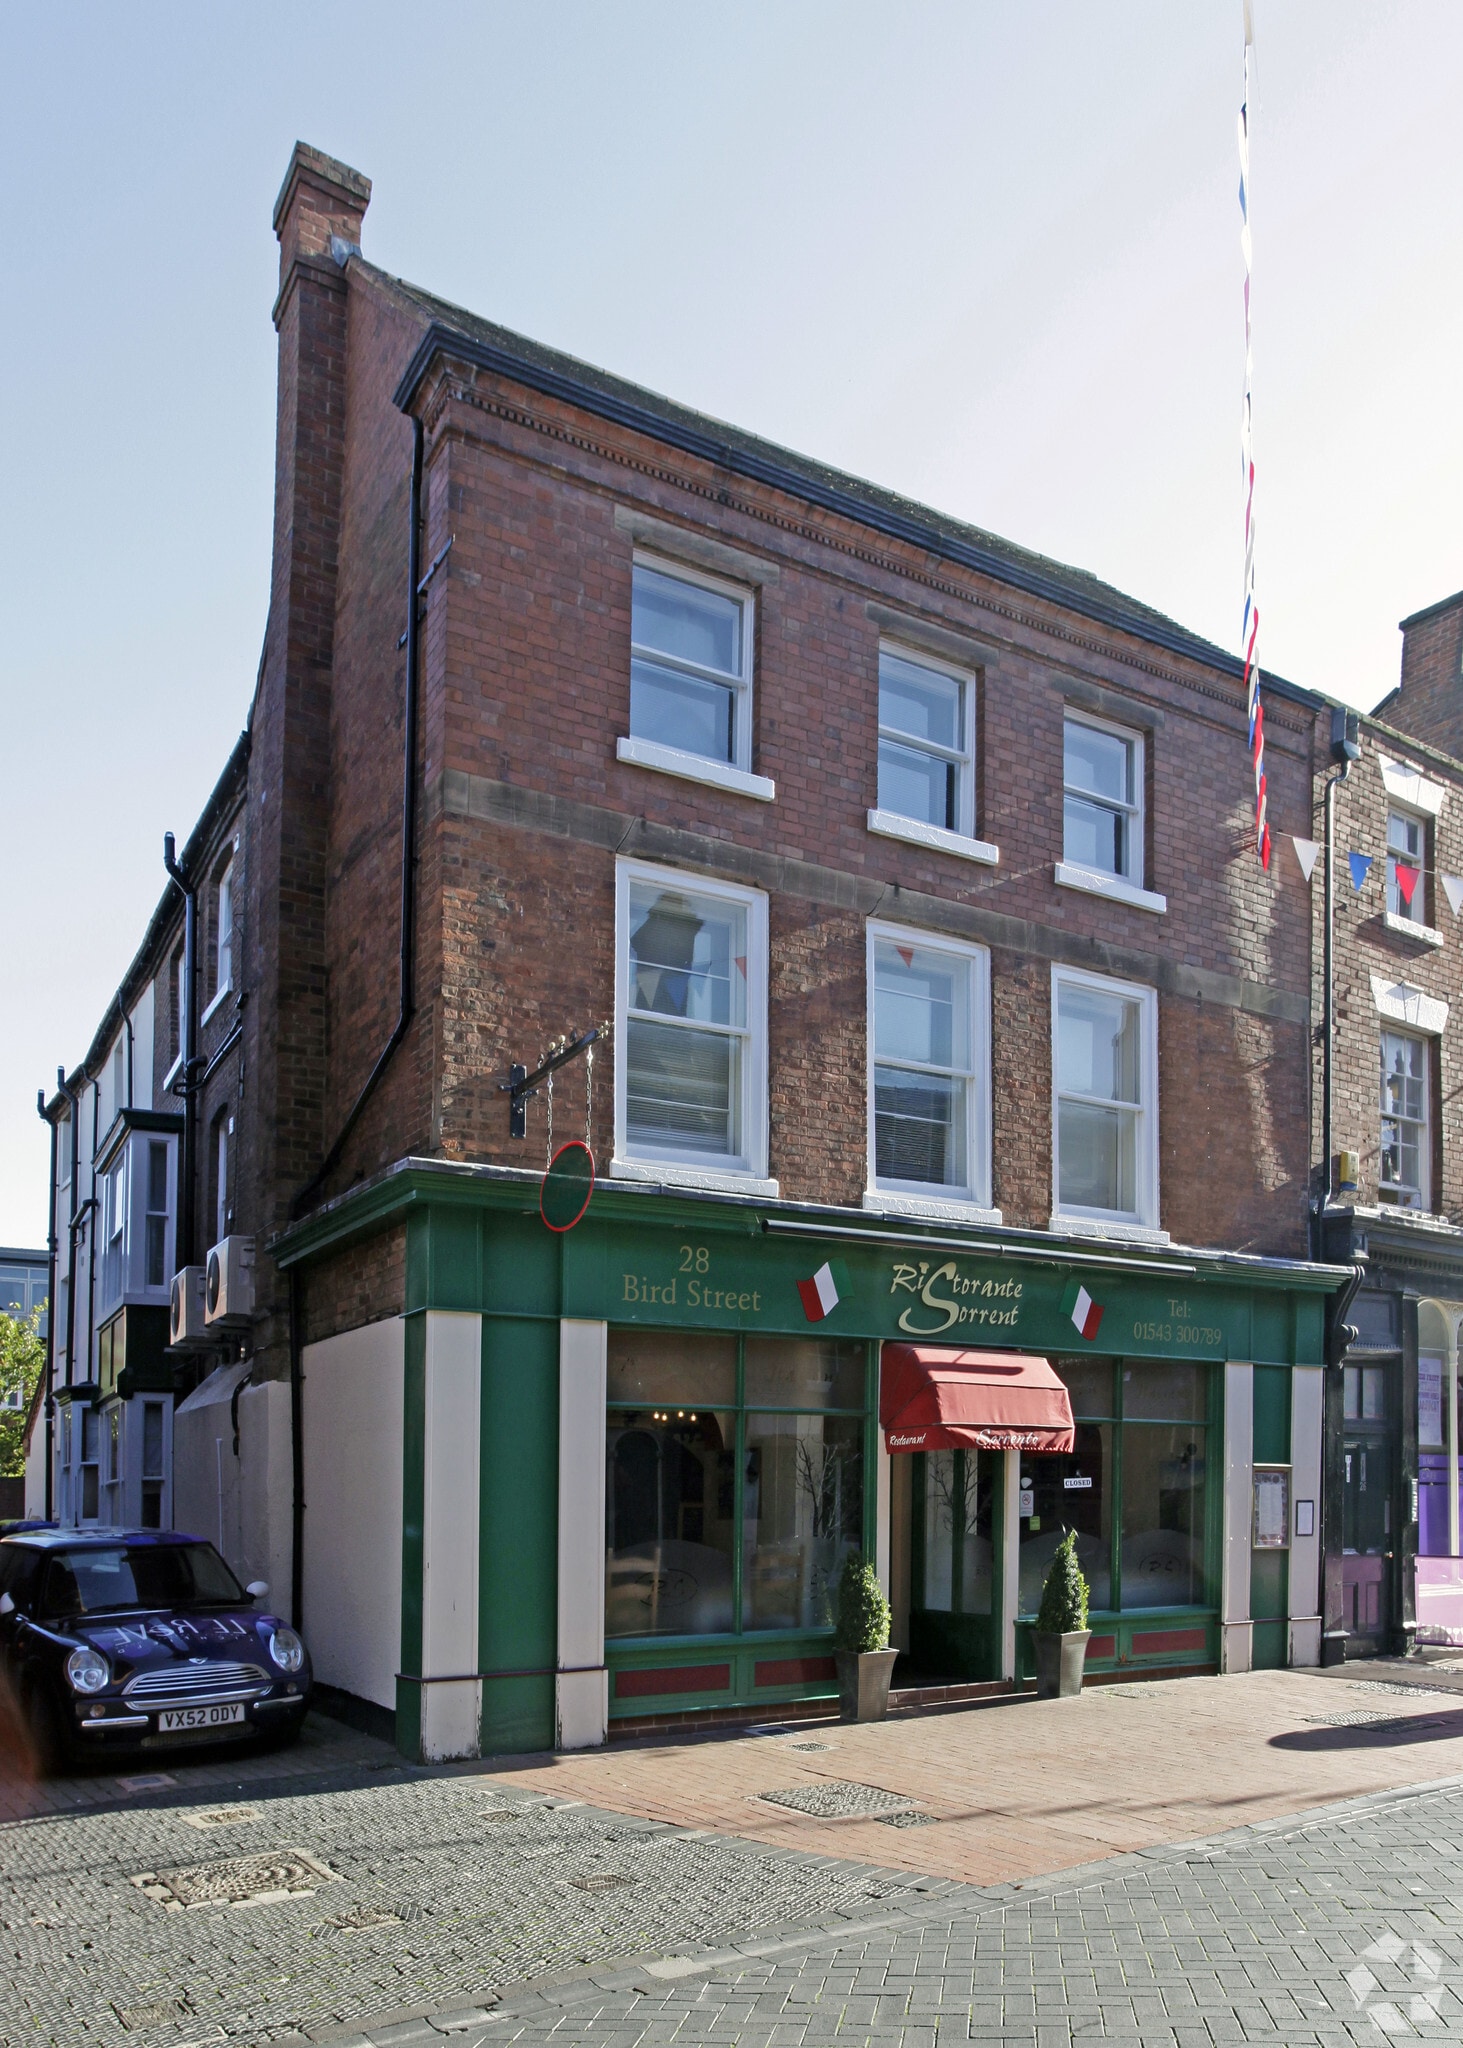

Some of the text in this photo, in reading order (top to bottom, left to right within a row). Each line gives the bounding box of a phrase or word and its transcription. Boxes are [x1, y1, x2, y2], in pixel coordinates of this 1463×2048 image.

[678, 1245, 710, 1273] 28
[622, 1274, 761, 1311] Bird Street
[1167, 1299, 1191, 1318] Tel:
[1133, 1322, 1222, 1345] 01543 300789
[889, 1432, 927, 1446] Restaurant
[975, 1428, 1040, 1446] Sorrento
[1065, 1479, 1091, 1487] CLOSED
[165, 1705, 239, 1728] VX52 ODY
